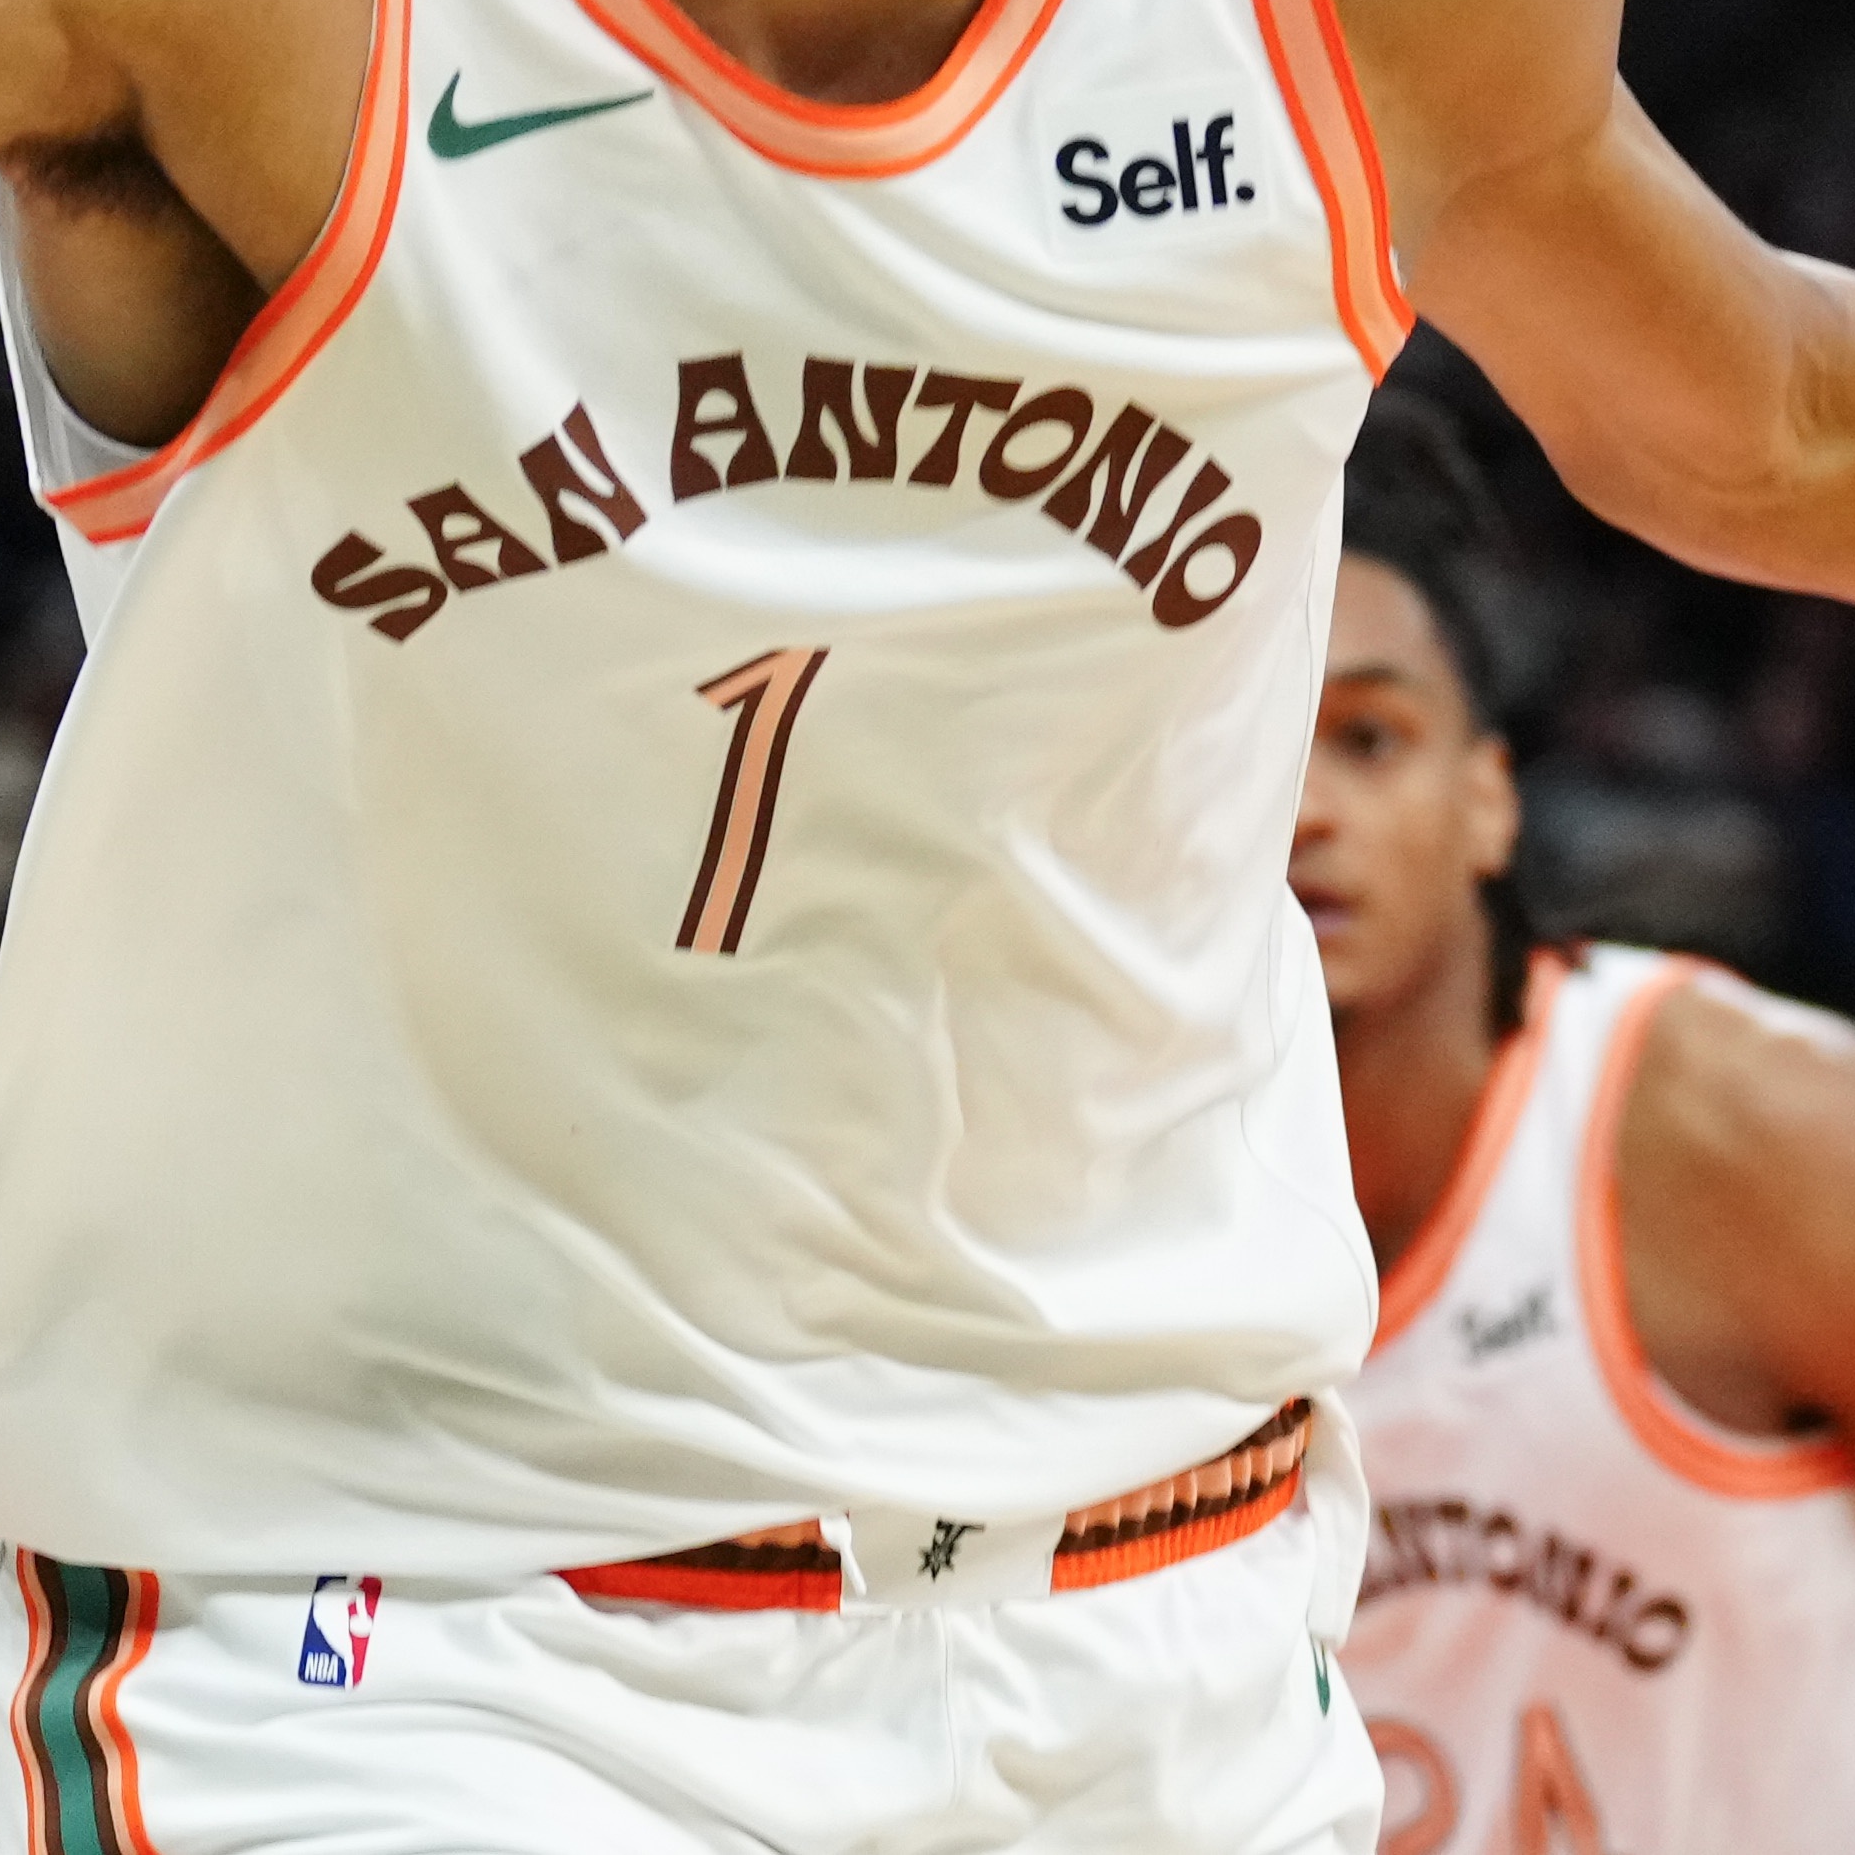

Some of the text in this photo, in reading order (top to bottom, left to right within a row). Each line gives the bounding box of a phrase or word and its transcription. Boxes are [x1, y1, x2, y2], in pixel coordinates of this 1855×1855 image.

[1055, 113, 1255, 226] Self.
[311, 351, 1262, 644] SAN ANTONIO
[673, 645, 831, 958] 1
[304, 1650, 339, 1683] NBA
[1356, 1496, 1692, 1674] NTONIO
